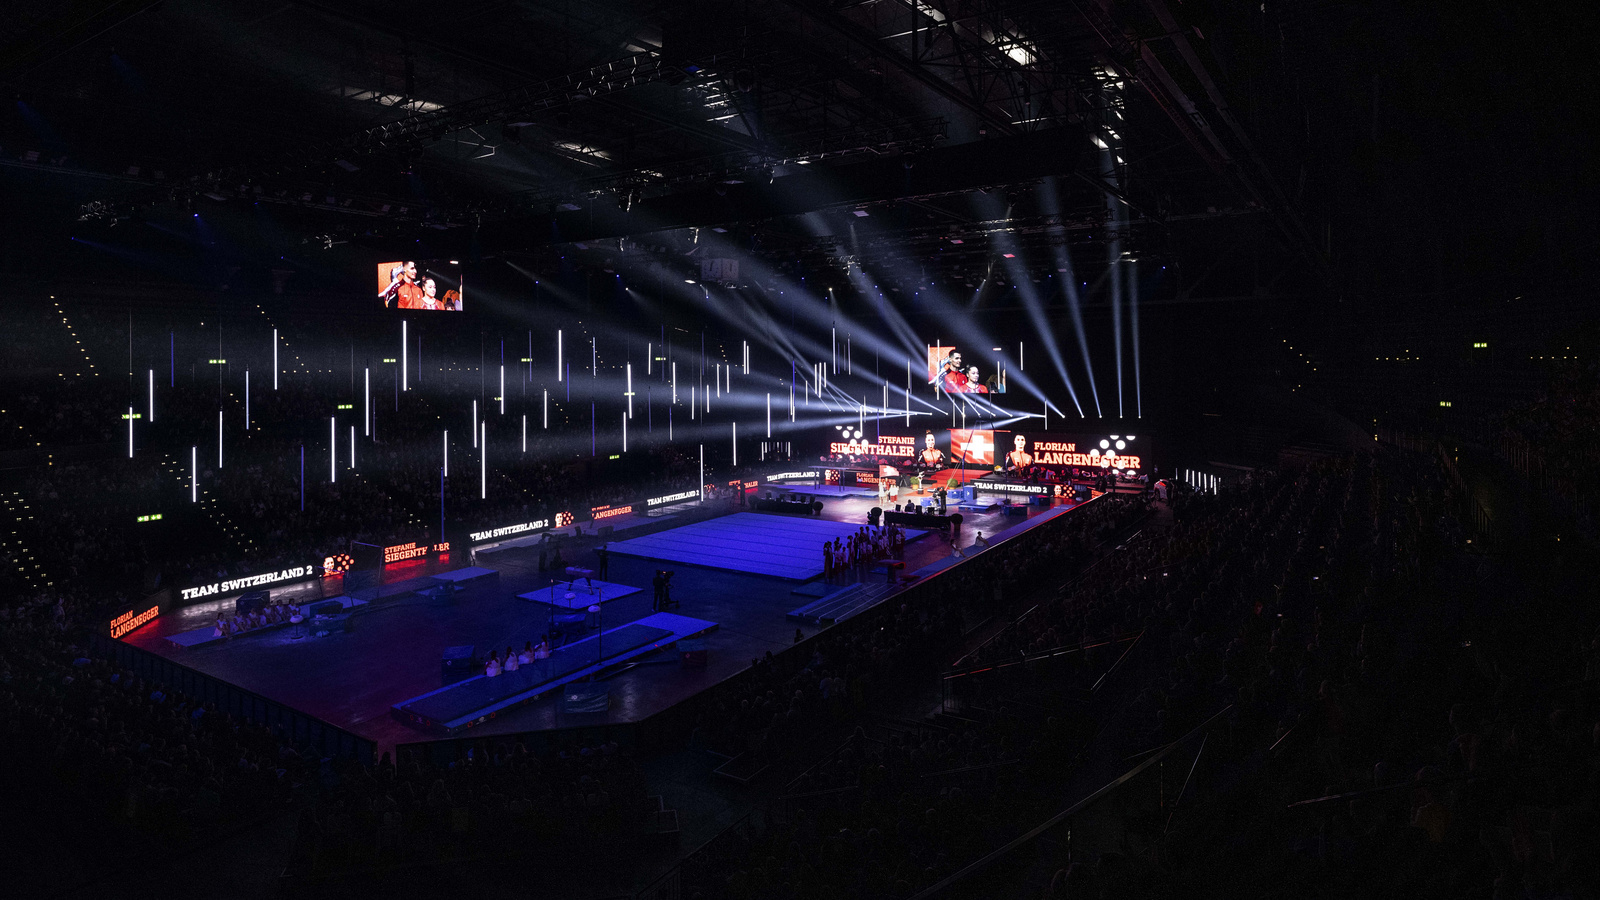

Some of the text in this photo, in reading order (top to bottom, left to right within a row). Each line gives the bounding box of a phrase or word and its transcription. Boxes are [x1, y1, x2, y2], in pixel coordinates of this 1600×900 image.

[878, 436, 915, 445] STEFANIE
[1034, 442, 1076, 452] FLORIAN
[830, 442, 915, 457] SIEGENTHALER
[1034, 452, 1141, 469] LANGENEGGER
[974, 482, 993, 490] TEAM
[994, 483, 1042, 493] SWITZERLAND
[647, 497, 662, 506] TEAM
[662, 491, 696, 503] SWITZERLAND
[470, 519, 549, 542] TEAM SWITZERLAND 2
[384, 542, 416, 555] STEFANIE
[181, 565, 313, 600] TEAM SWITZERLAND 2
[110, 609, 134, 630] FLORIAN
[110, 605, 159, 639] LANGENEGGER
